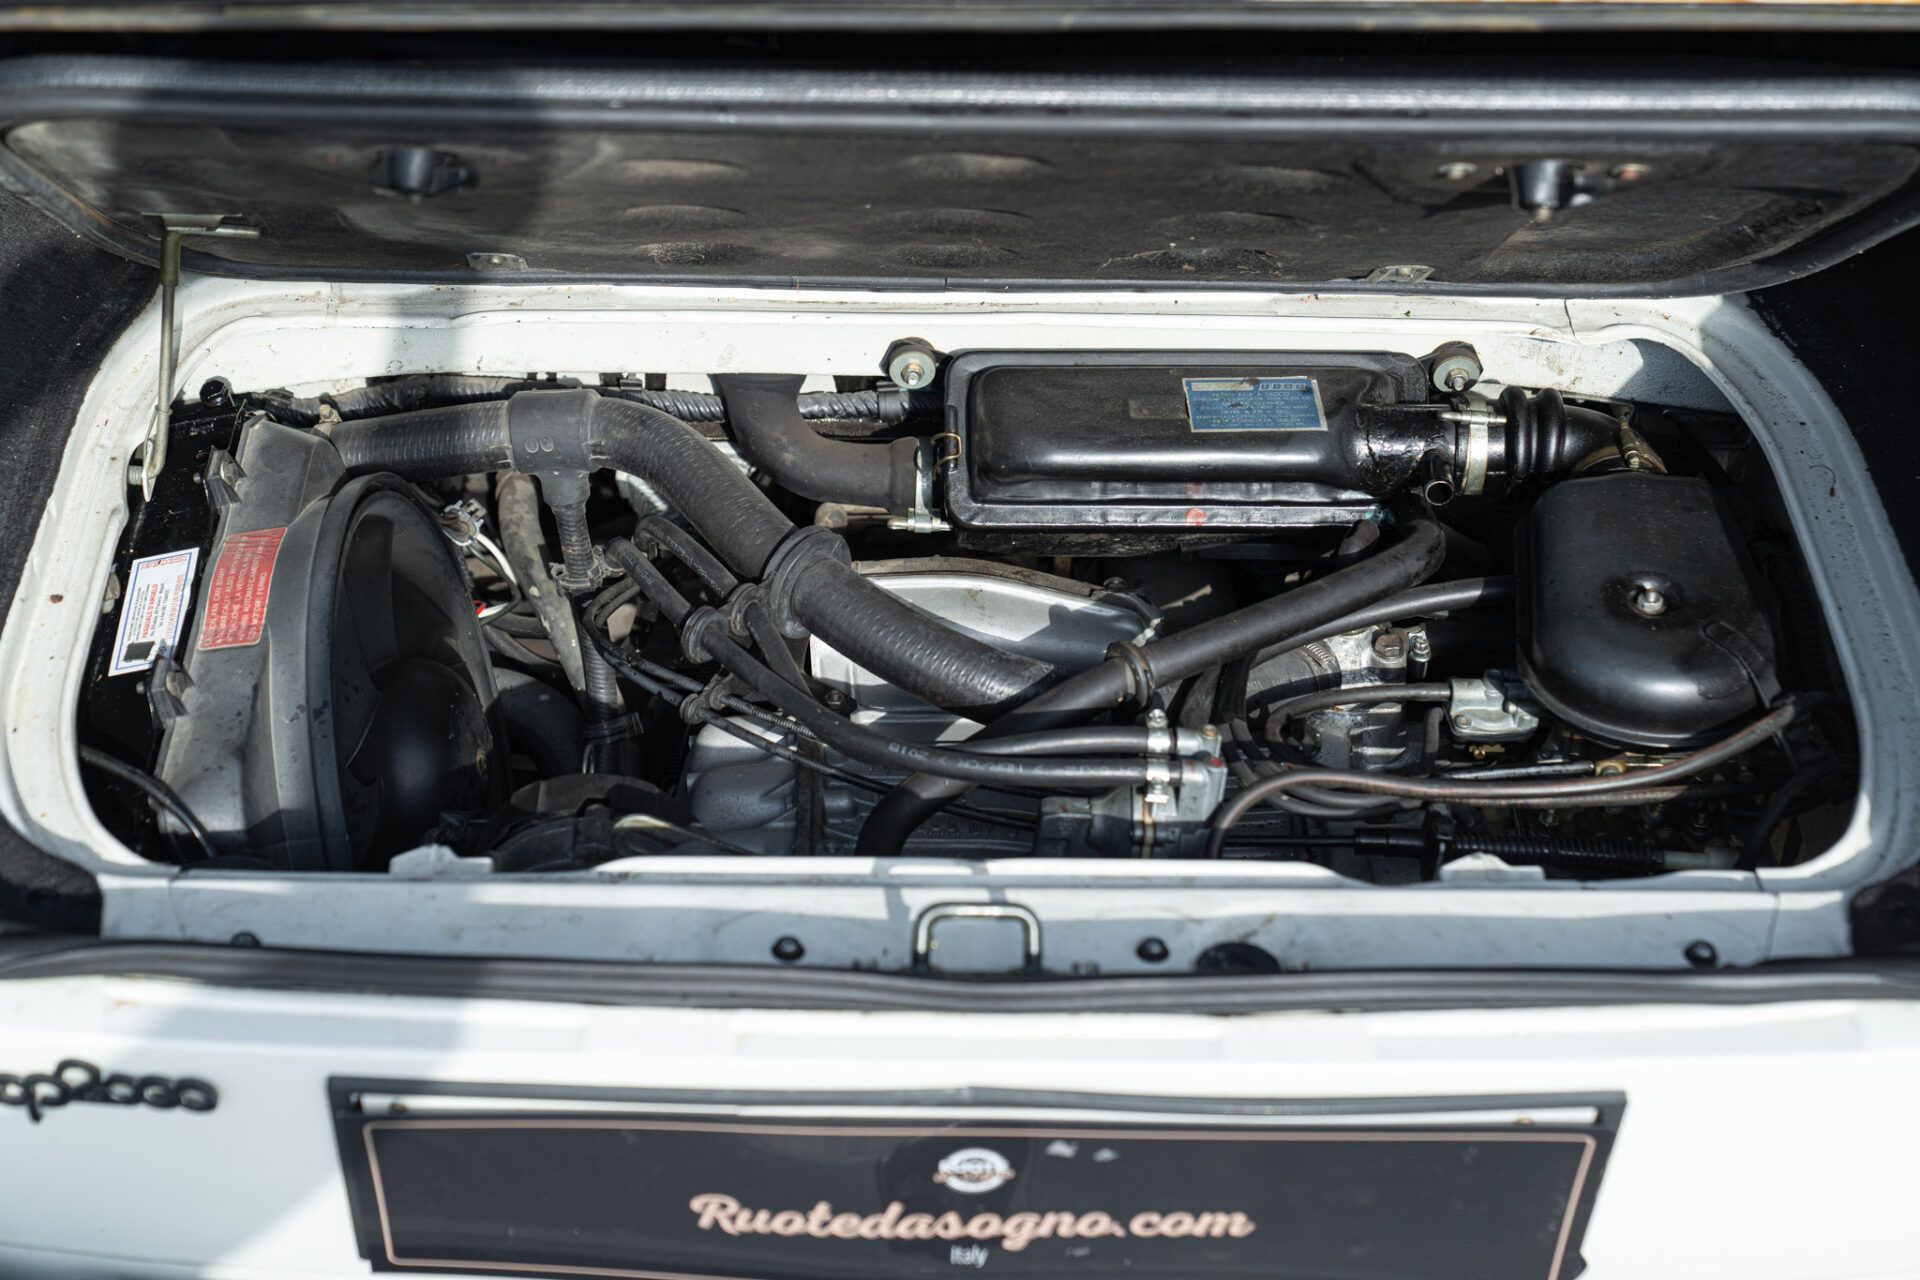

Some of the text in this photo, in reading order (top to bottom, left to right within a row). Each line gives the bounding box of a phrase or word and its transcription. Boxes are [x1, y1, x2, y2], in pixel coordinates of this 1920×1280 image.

[255, 570, 269, 595] FERMO
[688, 1191, 1256, 1252] Ruotedasogno.com
[950, 1243, 989, 1269] Italy
